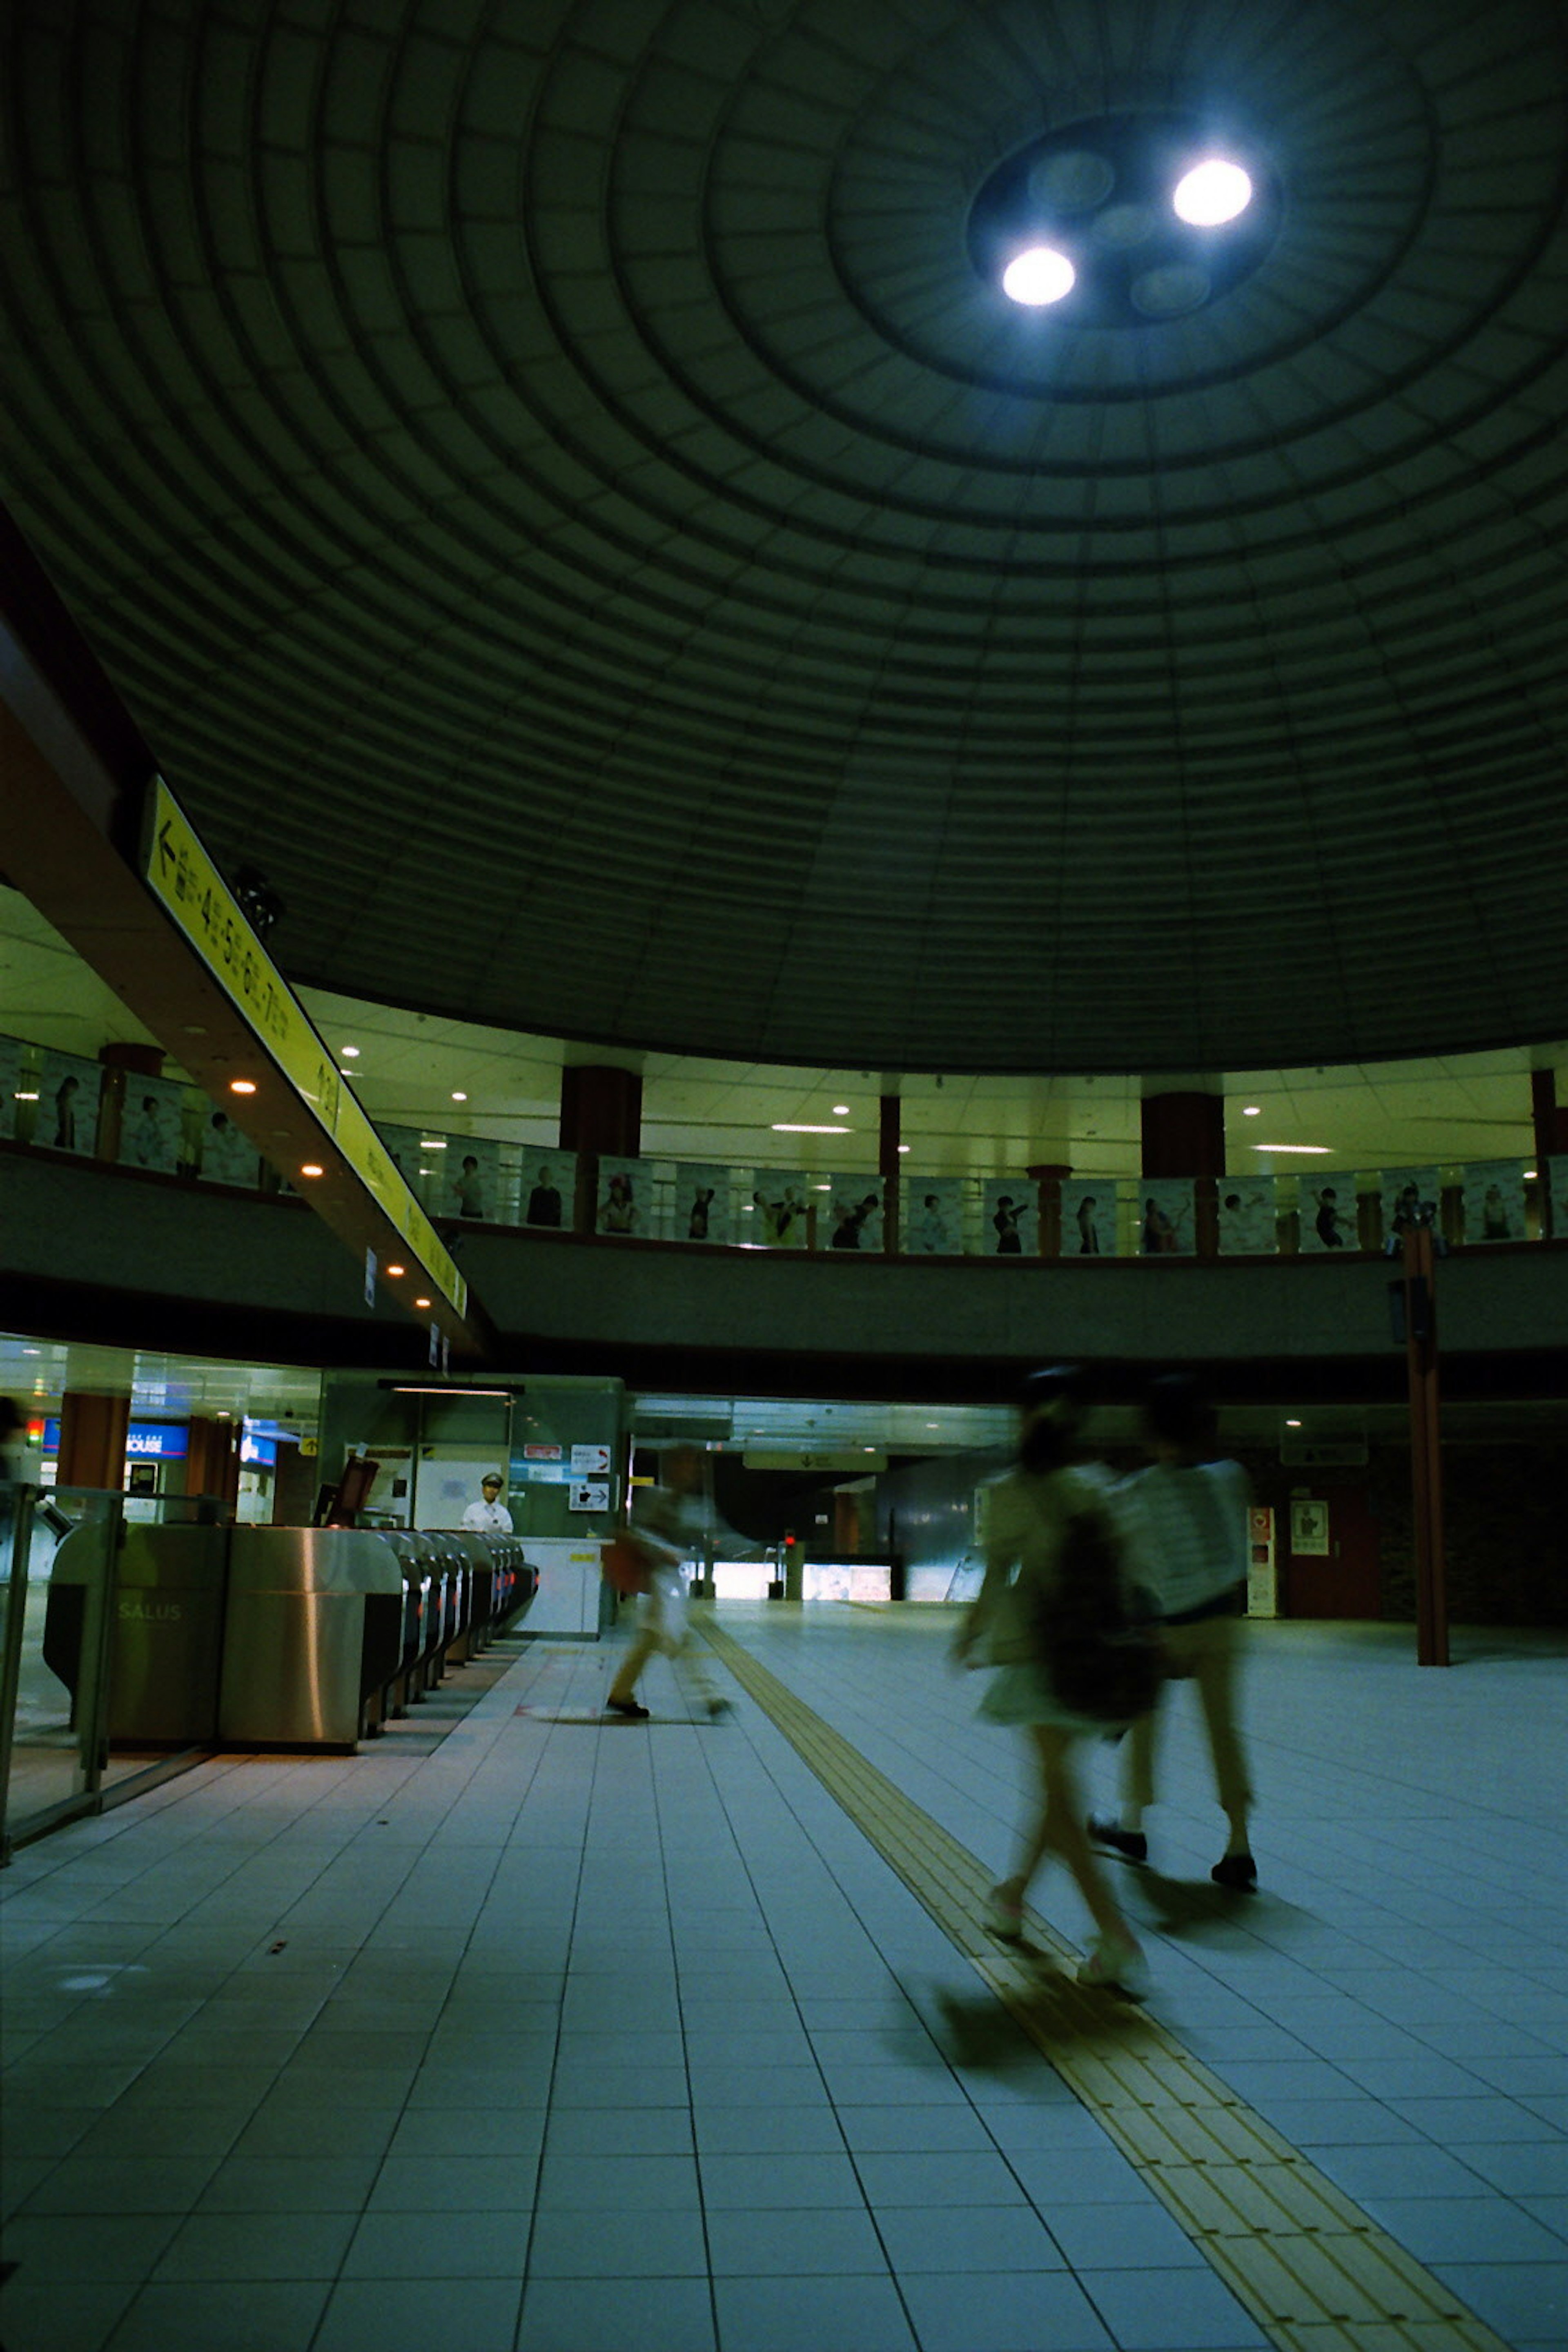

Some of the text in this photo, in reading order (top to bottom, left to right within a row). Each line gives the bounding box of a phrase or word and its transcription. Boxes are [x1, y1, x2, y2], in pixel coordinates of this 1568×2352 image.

[202, 889, 273, 1022] 4 5 6 7
[118, 1602, 182, 1620] SALUS
